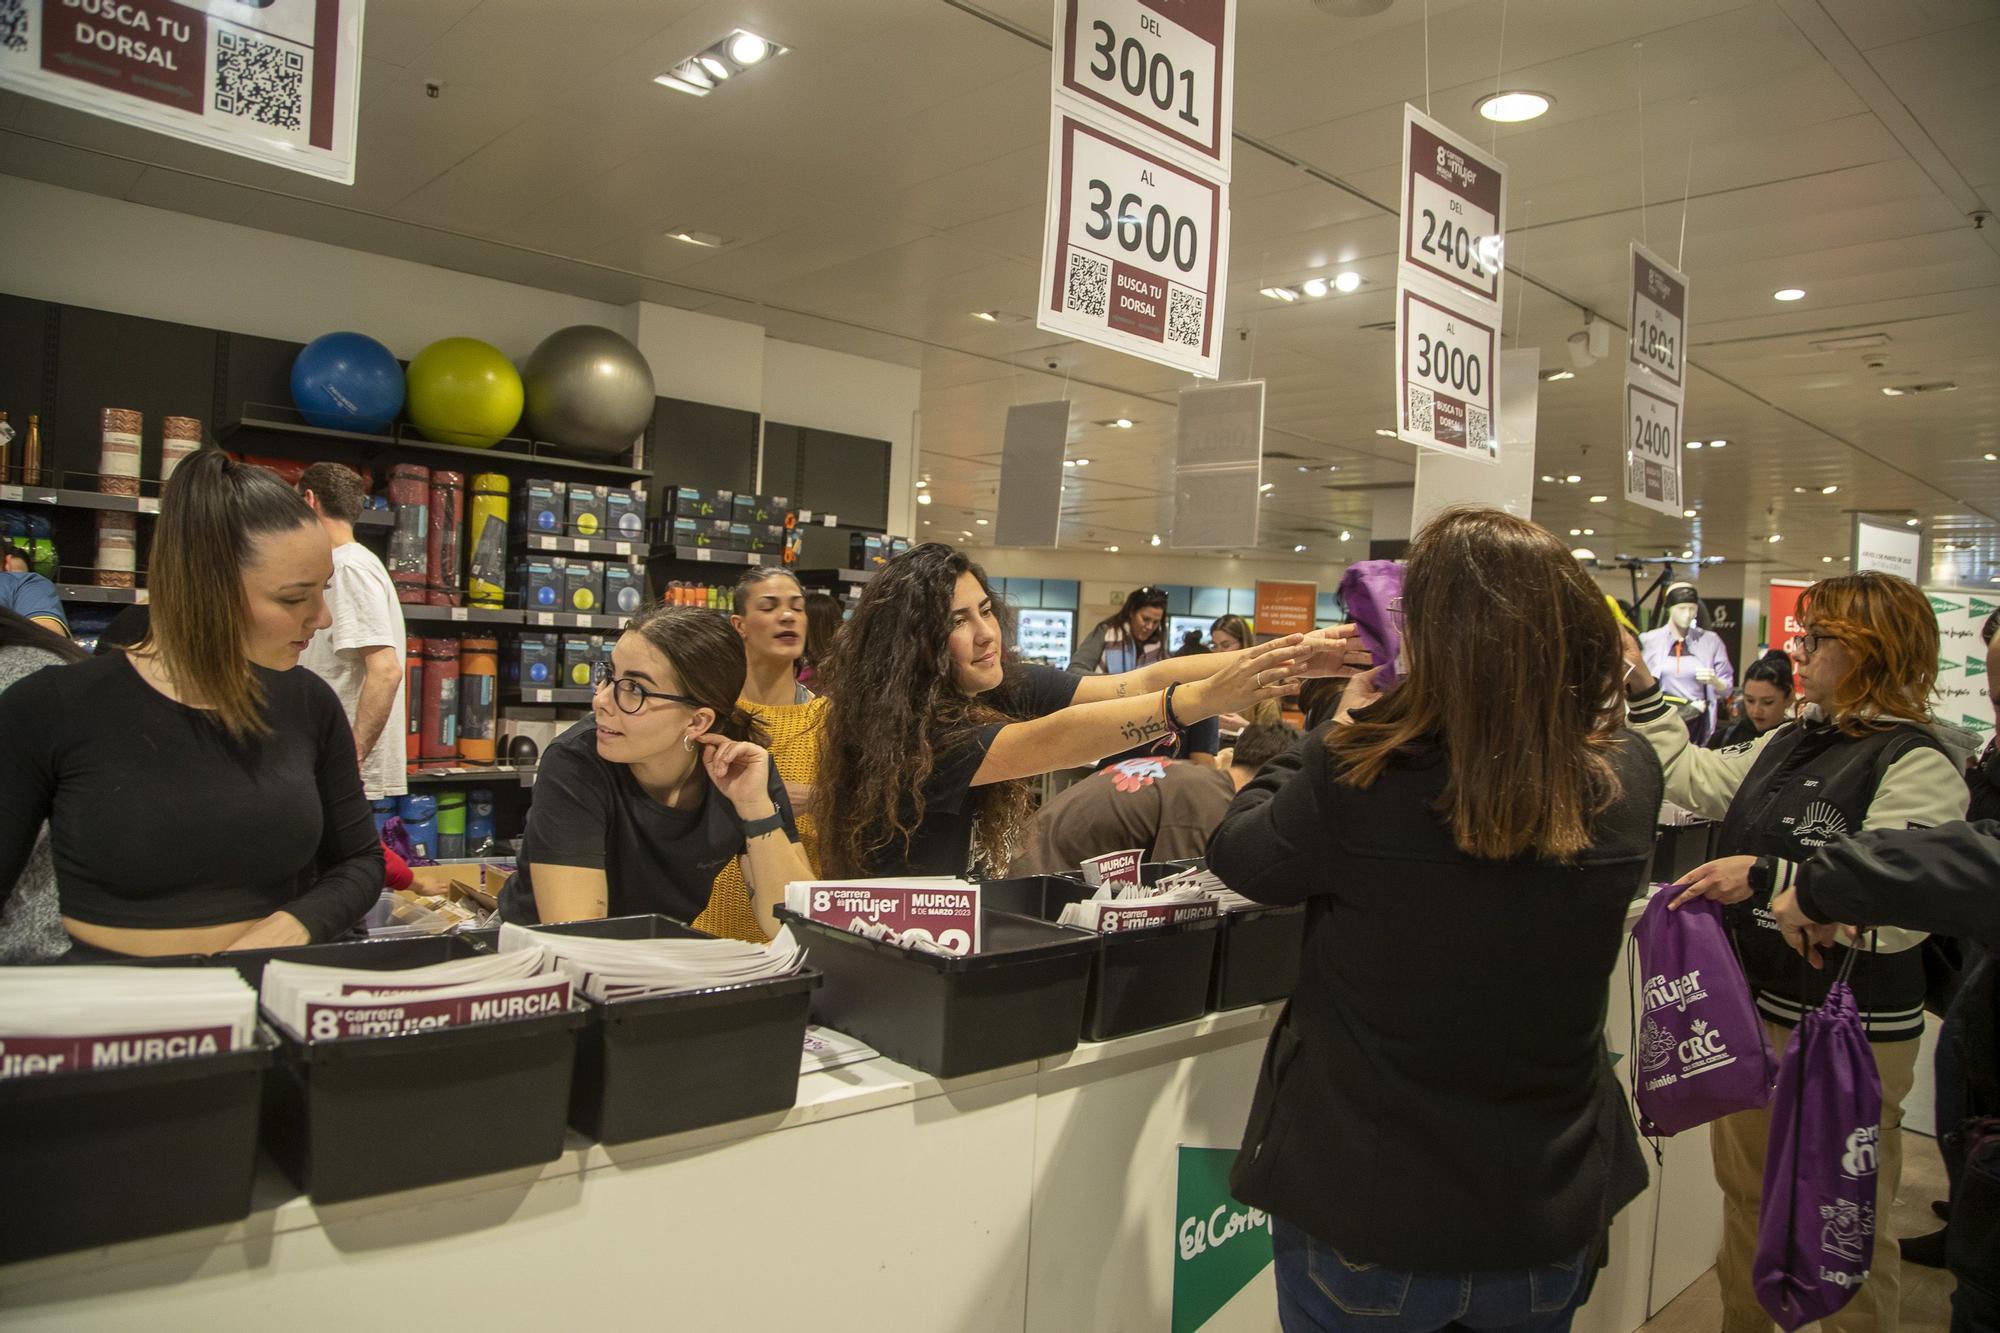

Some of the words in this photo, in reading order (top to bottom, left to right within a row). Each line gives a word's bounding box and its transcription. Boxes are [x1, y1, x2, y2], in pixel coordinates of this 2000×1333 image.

[157, 16, 190, 43] TU
[1140, 14, 1161, 38] DEL
[75, 22, 178, 70] DORSAL
[1090, 20, 1199, 127] 3001
[1140, 169, 1156, 187] AL
[1451, 160, 1477, 188] mujer
[1450, 199, 1463, 216] DEL
[1085, 179, 1198, 272] 3600
[1421, 208, 1485, 279] 2401
[1117, 274, 1148, 295] BUSCA
[1149, 285, 1162, 299] TU
[1120, 295, 1156, 317] DORSAL
[1446, 322, 1456, 336] AL
[1639, 319, 1675, 370] 1801
[1417, 333, 1480, 396] 3000
[1436, 400, 1456, 416] BUSCA
[1455, 406, 1464, 418] TU
[1635, 415, 1670, 459] 2400
[1100, 855, 1135, 874] MURCIA
[834, 890, 871, 899] carrera
[911, 894, 970, 908] MURCIA
[844, 898, 900, 922] mujer
[911, 907, 917, 915] 5
[917, 907, 928, 915] DE
[928, 908, 954, 916] MARZO
[954, 908, 971, 916] 2023
[1122, 910, 1148, 919] carrera
[1173, 906, 1213, 922] MURCIA
[344, 1007, 405, 1022] carrera
[470, 991, 562, 1022] MURCIA
[92, 1033, 218, 1067] MURCIA
[1678, 1029, 1727, 1064] CRC
[1179, 1216, 1207, 1261] El
